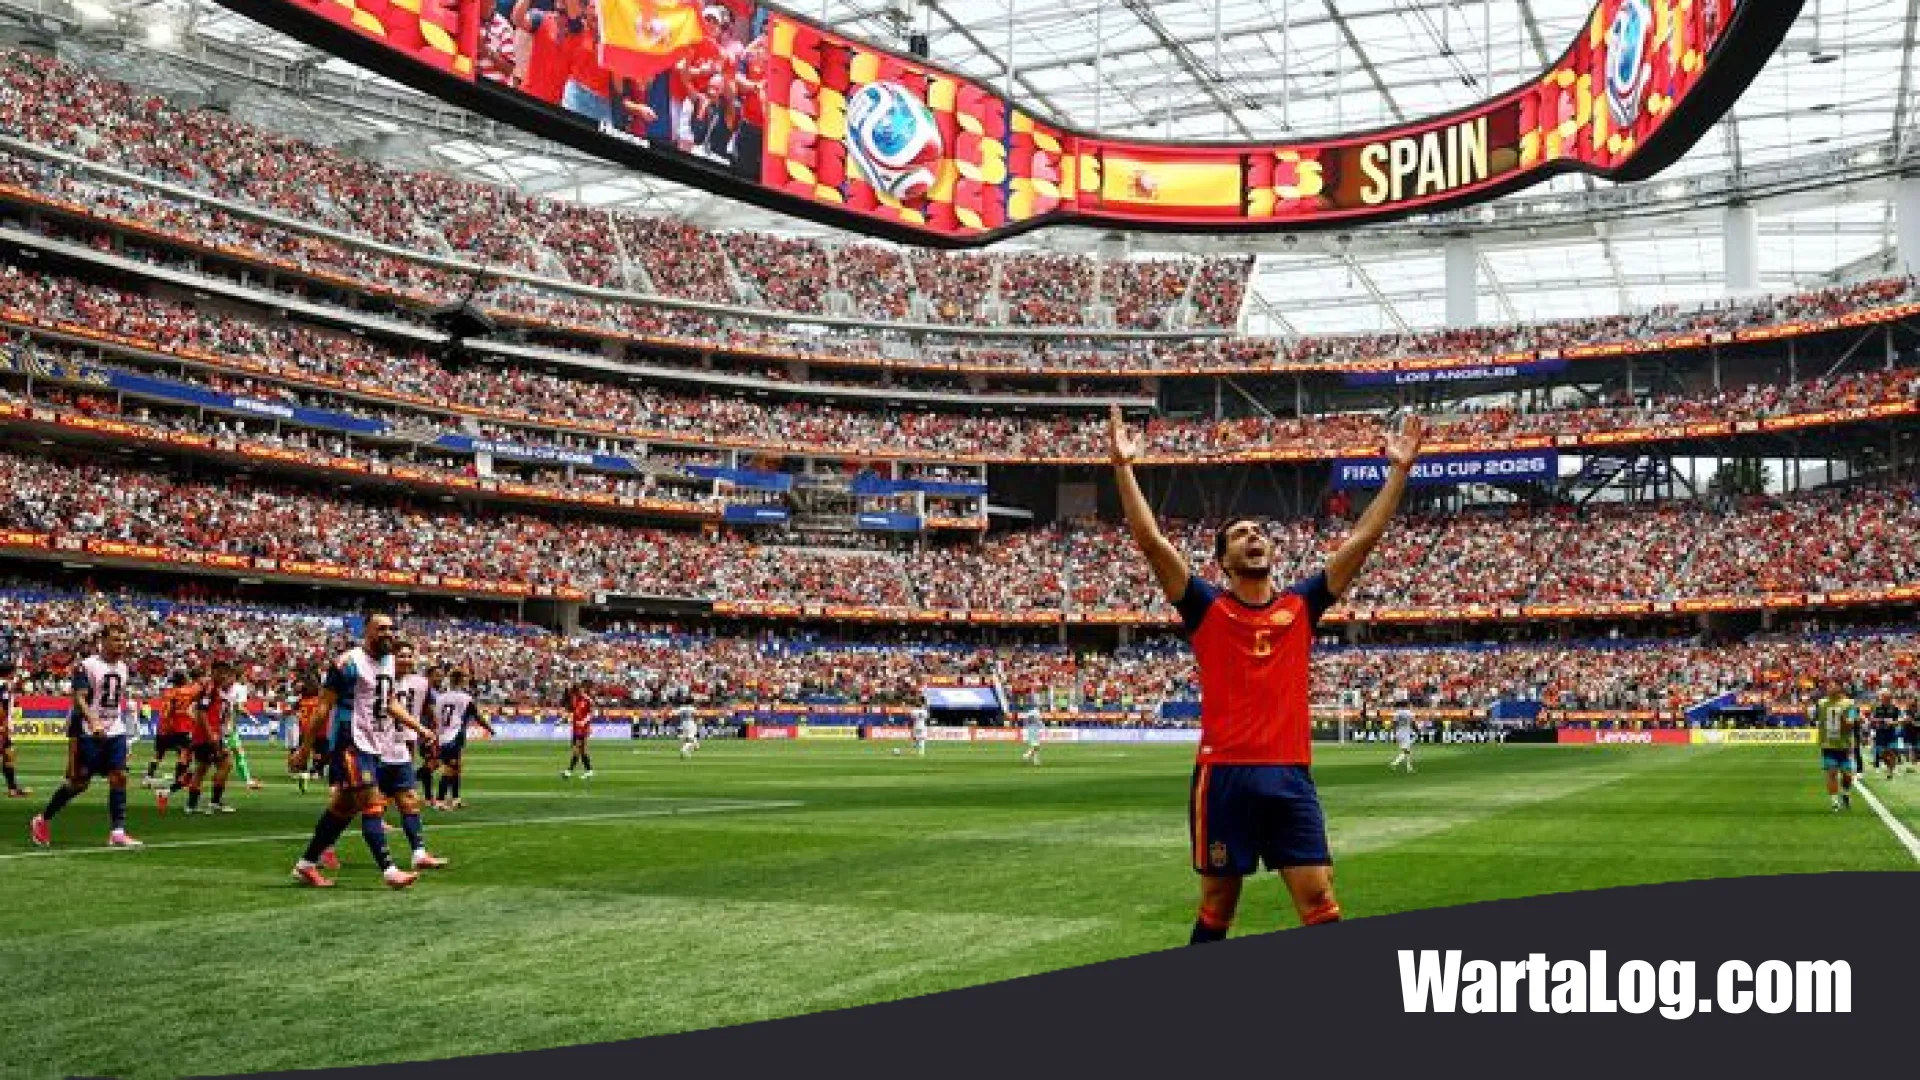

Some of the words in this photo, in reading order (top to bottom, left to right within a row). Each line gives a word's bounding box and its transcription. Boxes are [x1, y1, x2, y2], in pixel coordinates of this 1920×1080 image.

[1360, 117, 1488, 204] SPAIN
[1395, 373, 1430, 383] LOS
[1434, 366, 1517, 381] ANGELES
[1343, 465, 1380, 481] FIFA
[1382, 462, 1443, 479] WRLD
[1447, 461, 1482, 477] CUP
[1484, 457, 1546, 475] 2026
[1253, 629, 1273, 657] 6
[1353, 730, 1436, 743] MAROTT
[1595, 730, 1652, 743] Lenovo
